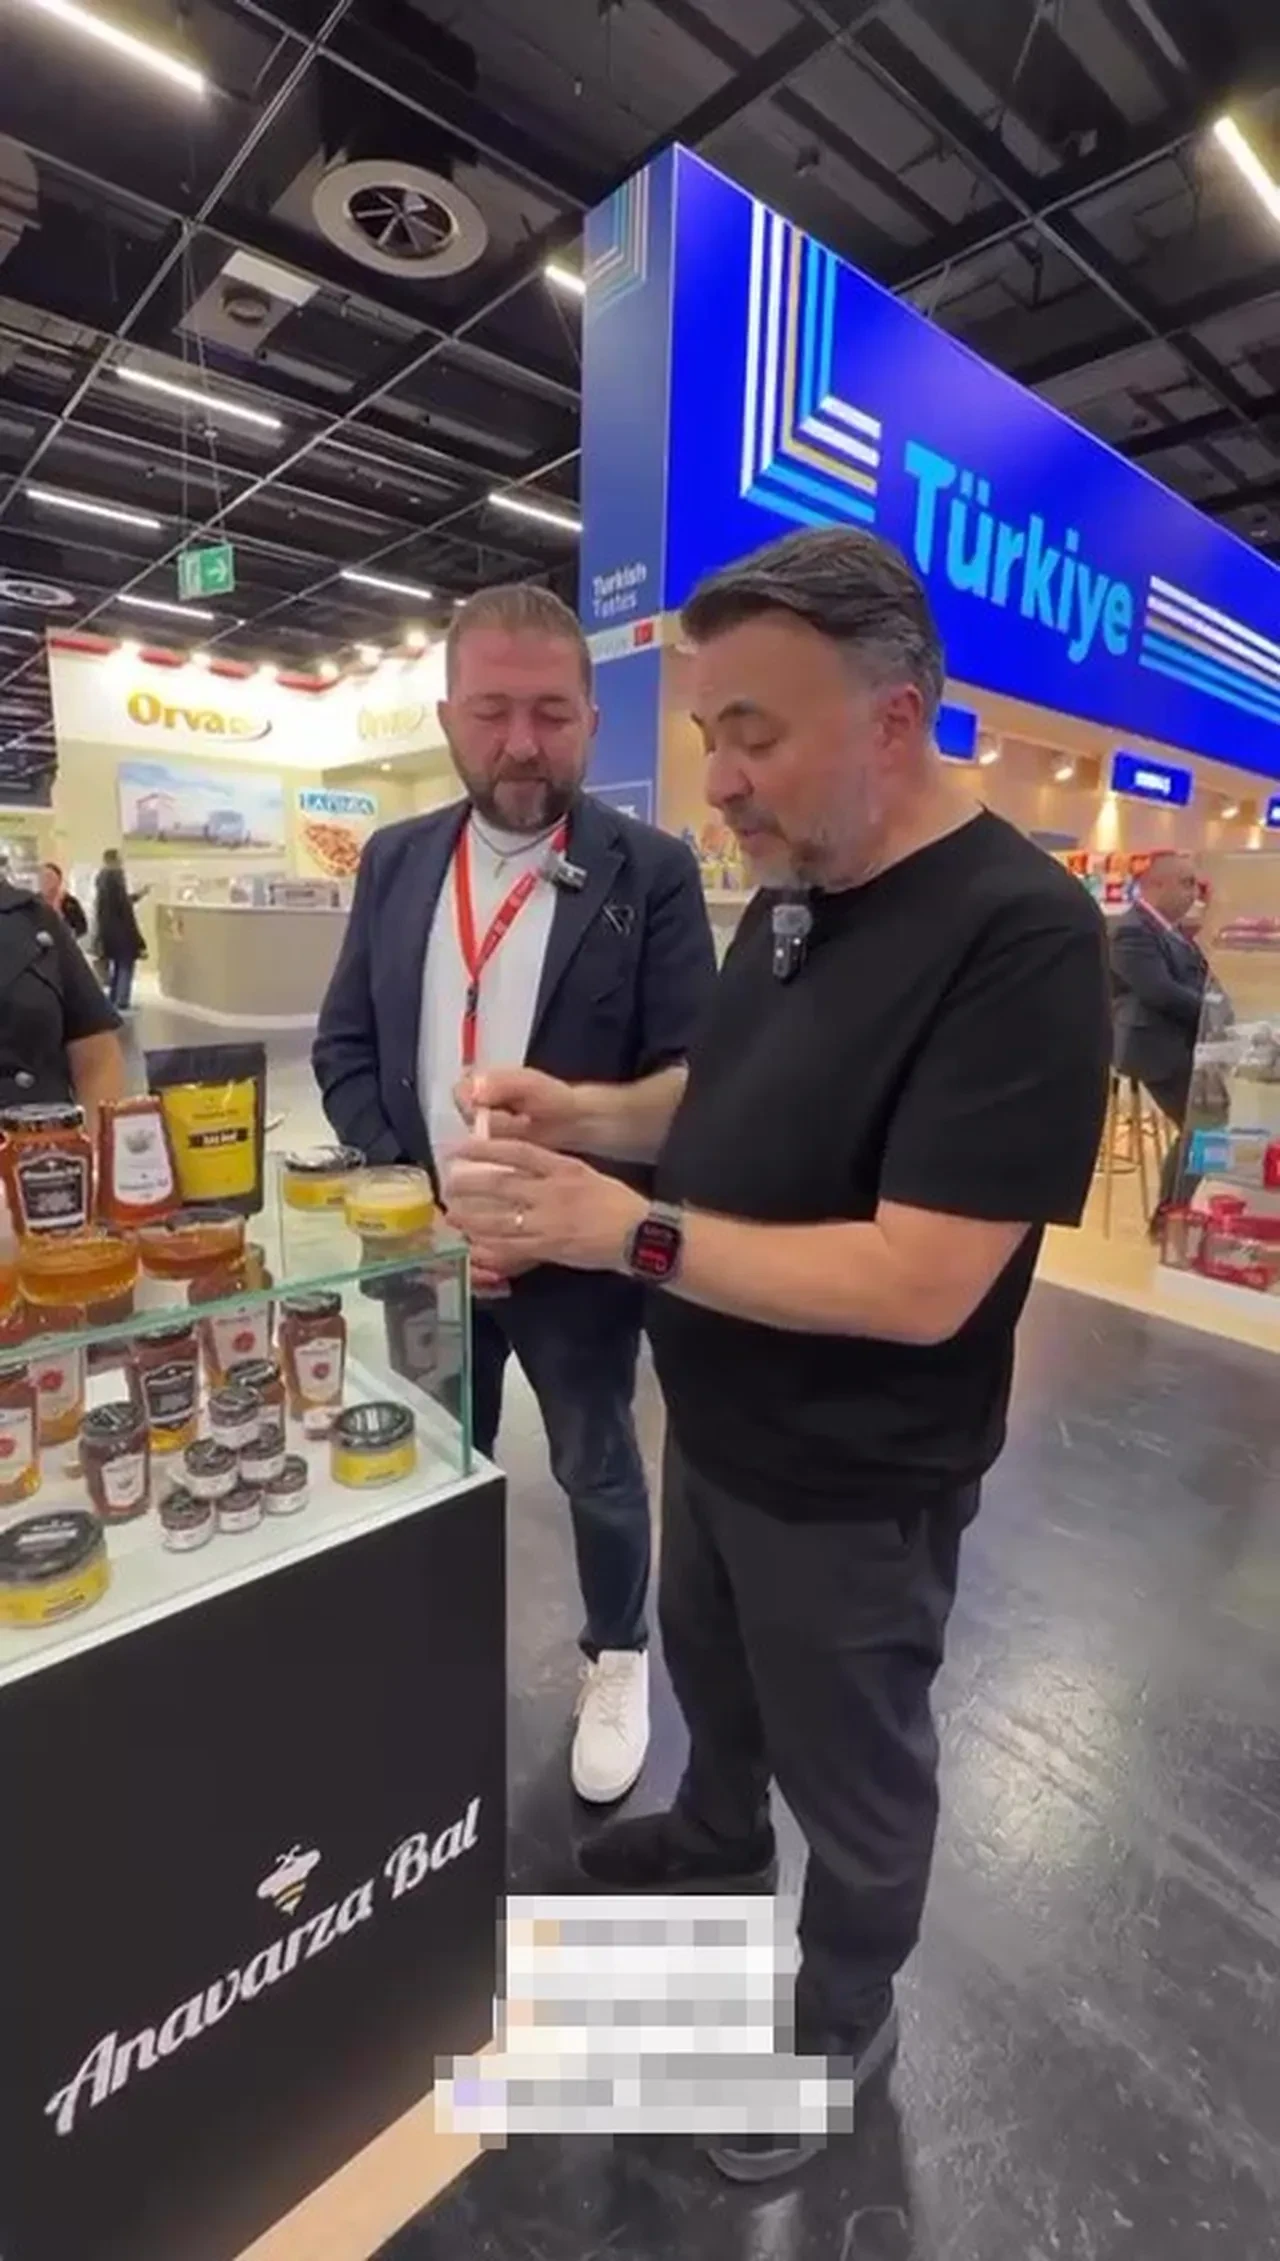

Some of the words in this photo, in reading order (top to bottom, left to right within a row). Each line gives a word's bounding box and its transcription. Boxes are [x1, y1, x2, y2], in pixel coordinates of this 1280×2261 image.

[592, 561, 647, 598] Turkish
[904, 439, 1133, 664] Türkiye
[44, 1878, 374, 2136] Anavarza
[384, 1796, 481, 1899] Bal
